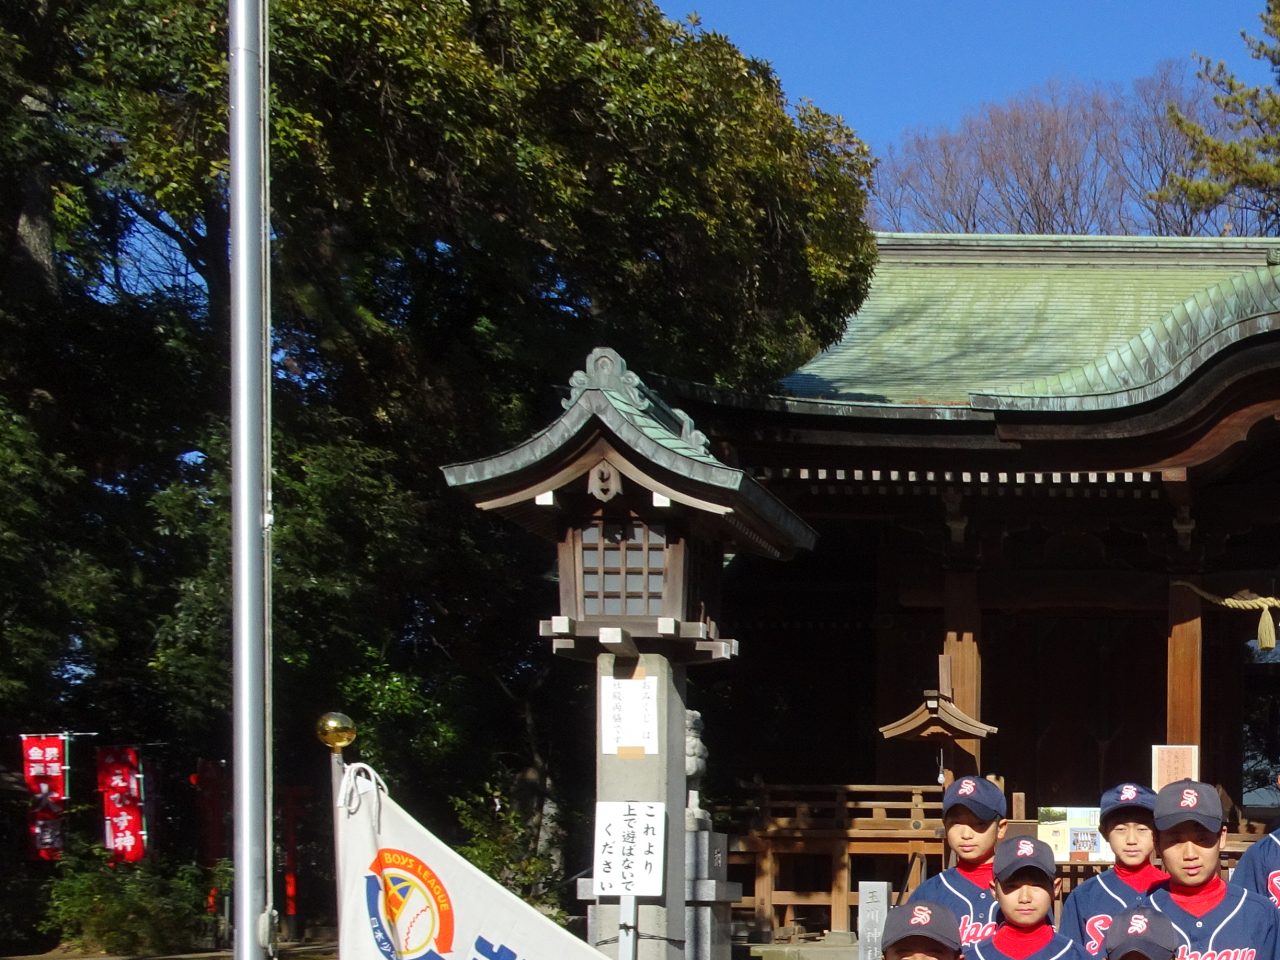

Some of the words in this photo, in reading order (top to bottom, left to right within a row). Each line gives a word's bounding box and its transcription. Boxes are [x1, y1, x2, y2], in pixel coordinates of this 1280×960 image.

[958, 779, 976, 796] S
[1120, 785, 1137, 800] S
[1180, 789, 1199, 808] S
[621, 804, 638, 892] 上で遊ばないで
[643, 805, 657, 875] これより
[1017, 840, 1034, 857] S
[600, 823, 614, 891] ください
[384, 852, 415, 869] BOYS
[417, 864, 450, 912] LEAGUE
[910, 906, 932, 926] S
[1127, 914, 1148, 935] S
